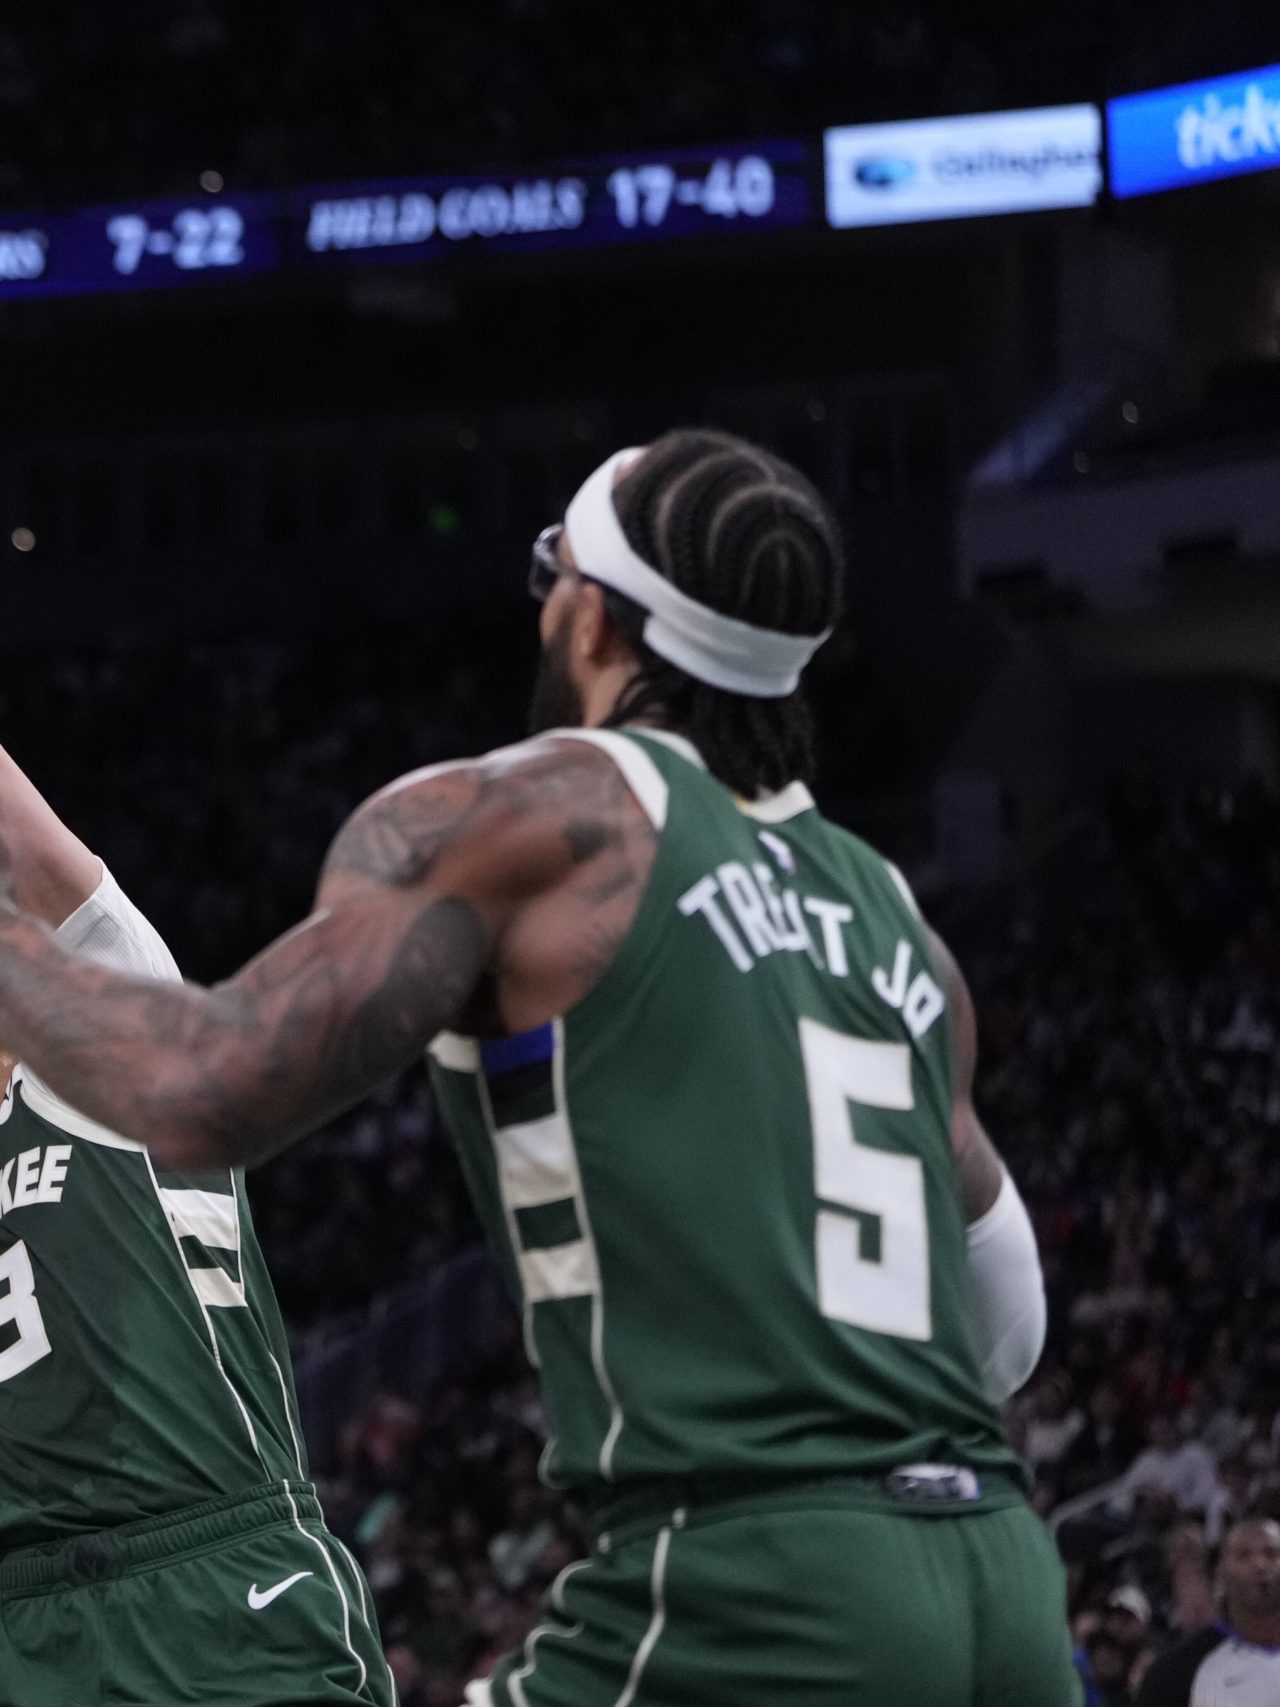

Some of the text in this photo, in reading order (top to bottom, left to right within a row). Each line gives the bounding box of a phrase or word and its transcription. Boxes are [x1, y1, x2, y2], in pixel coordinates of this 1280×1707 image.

[1175, 82, 1280, 168] tick
[607, 154, 775, 228] 17-40
[106, 206, 245, 275] 7-22
[798, 1016, 933, 1342] 5
